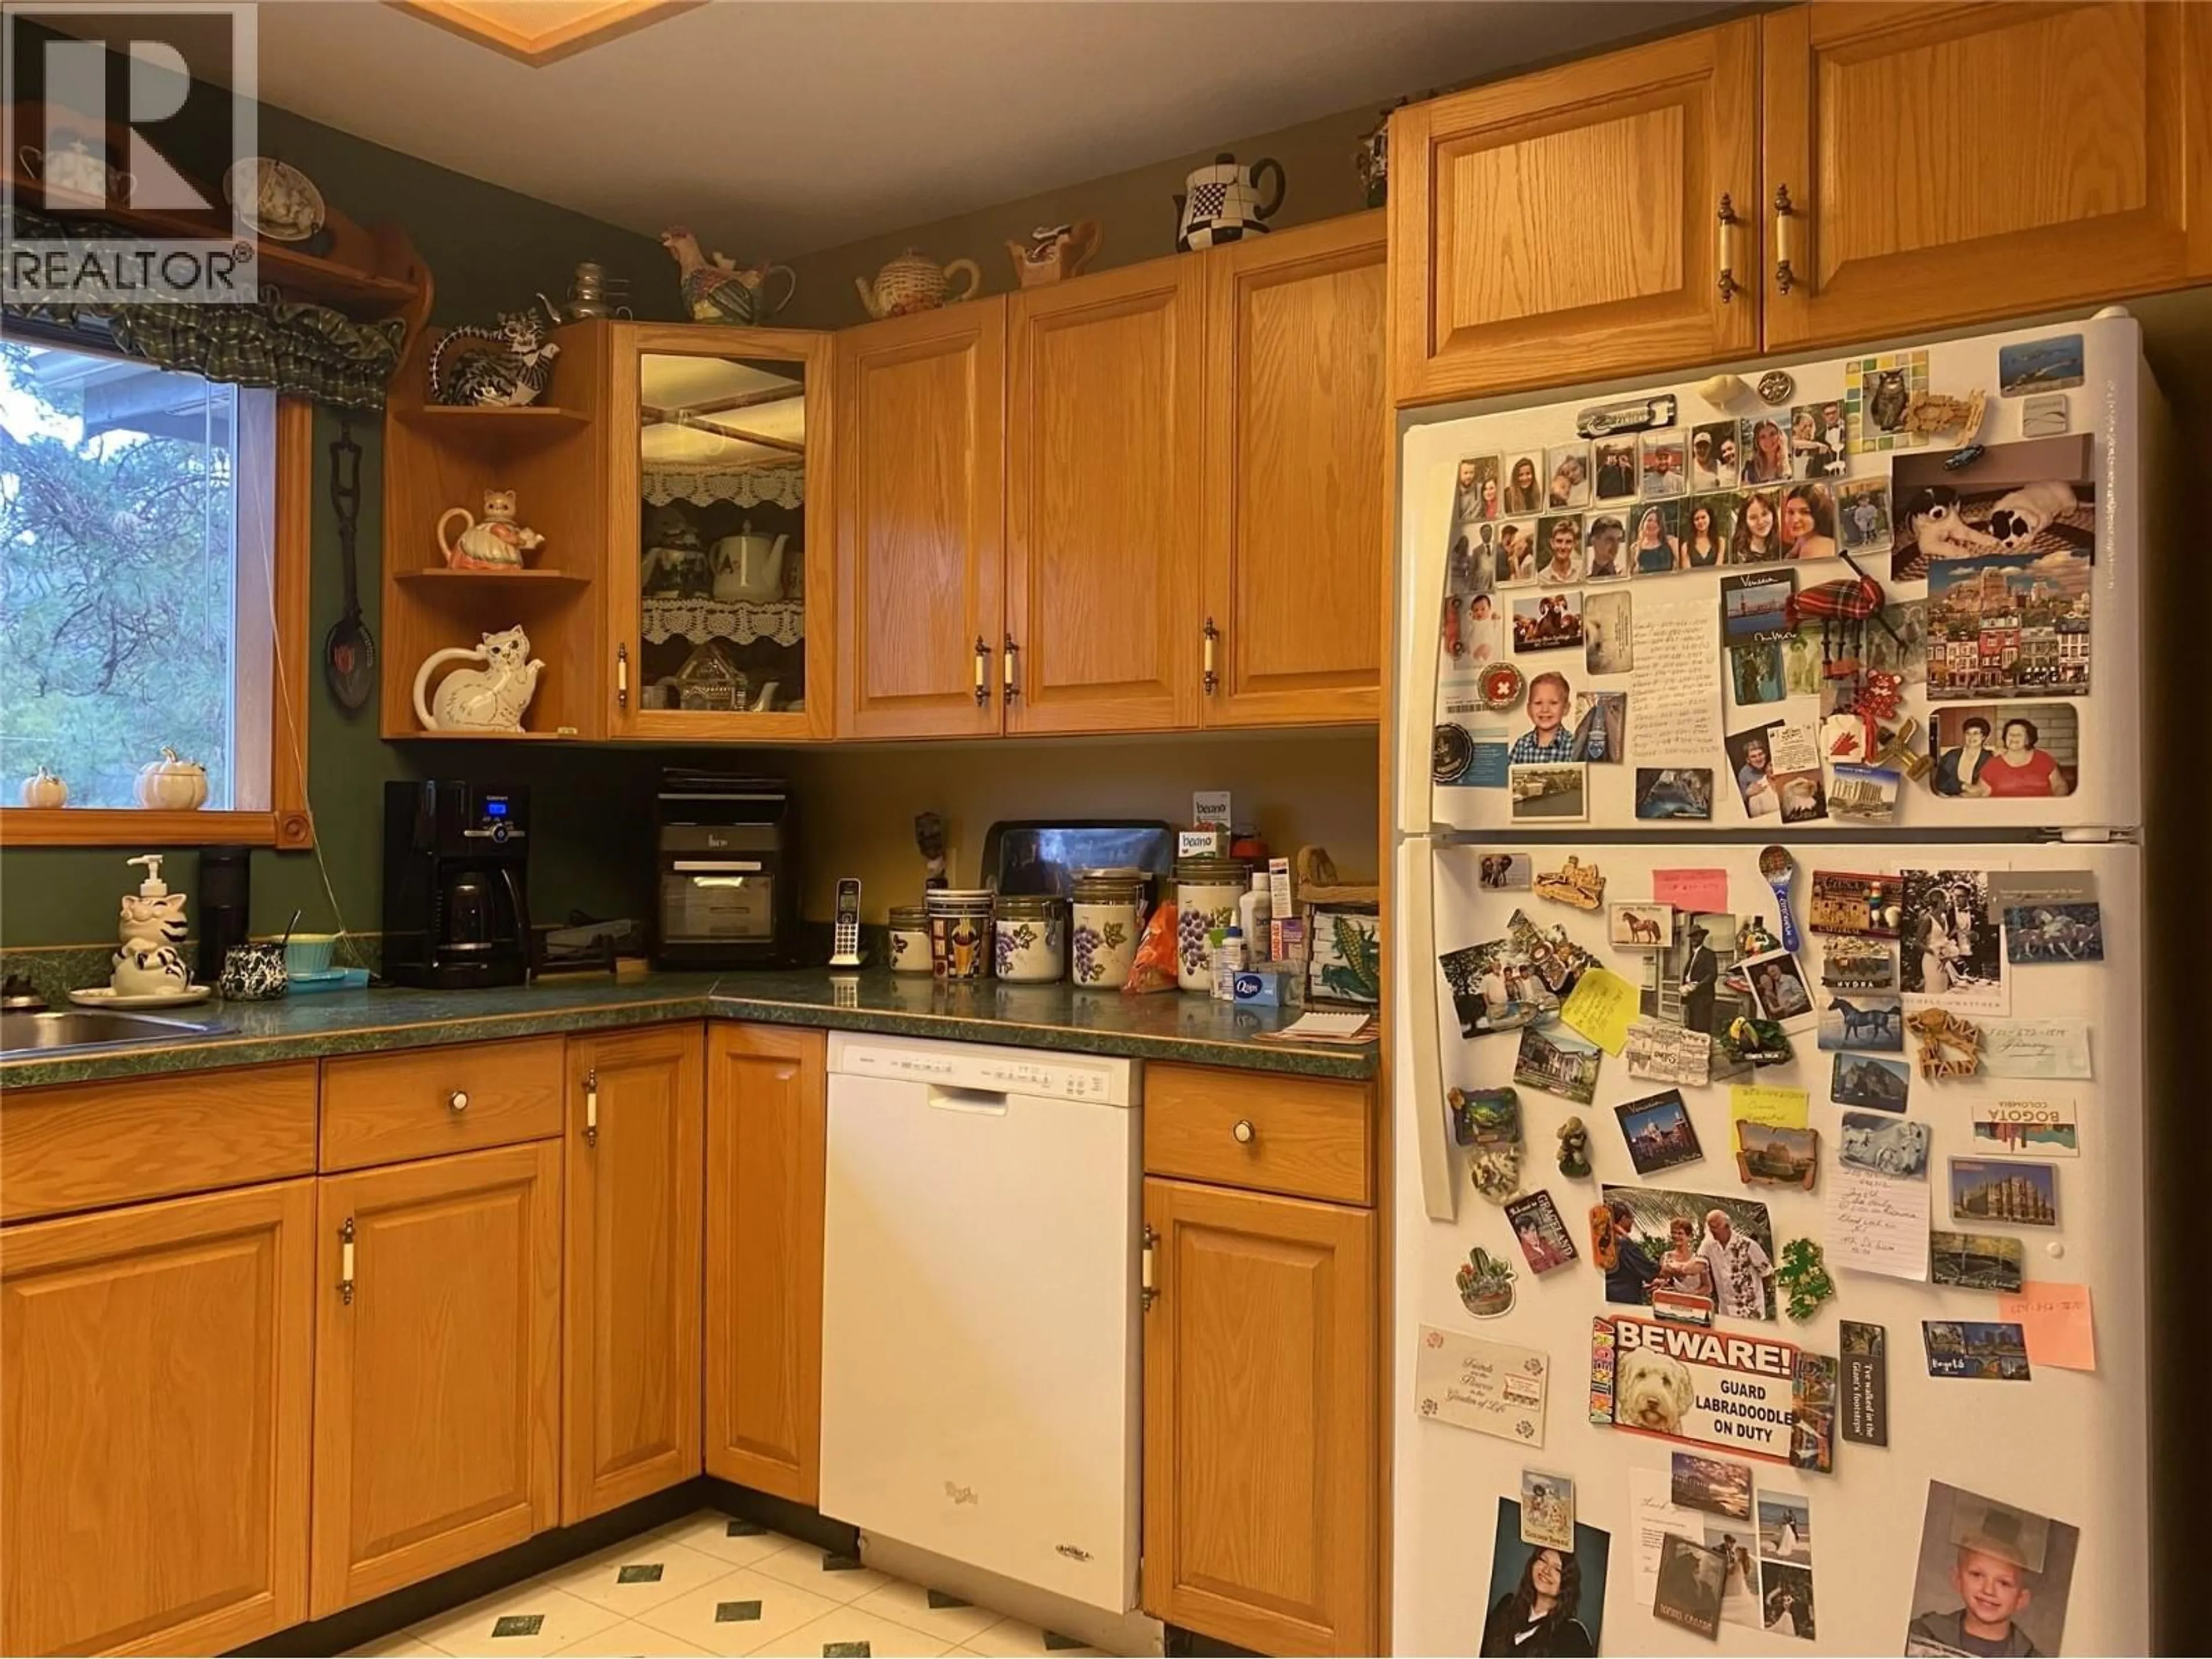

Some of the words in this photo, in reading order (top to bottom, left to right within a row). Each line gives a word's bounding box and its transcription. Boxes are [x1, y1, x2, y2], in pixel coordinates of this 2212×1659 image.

[1196, 801, 1226, 814] beano
[1183, 834, 1212, 847] beano
[1988, 1109, 2060, 1122] BOGOTA
[1616, 1320, 1793, 1375] BEWARE!
[1721, 1380, 1766, 1400] GUARD
[1696, 1395, 1793, 1426] LABRADOODLE
[1714, 1419, 1733, 1435] ON
[1736, 1423, 1773, 1443] DUTY
